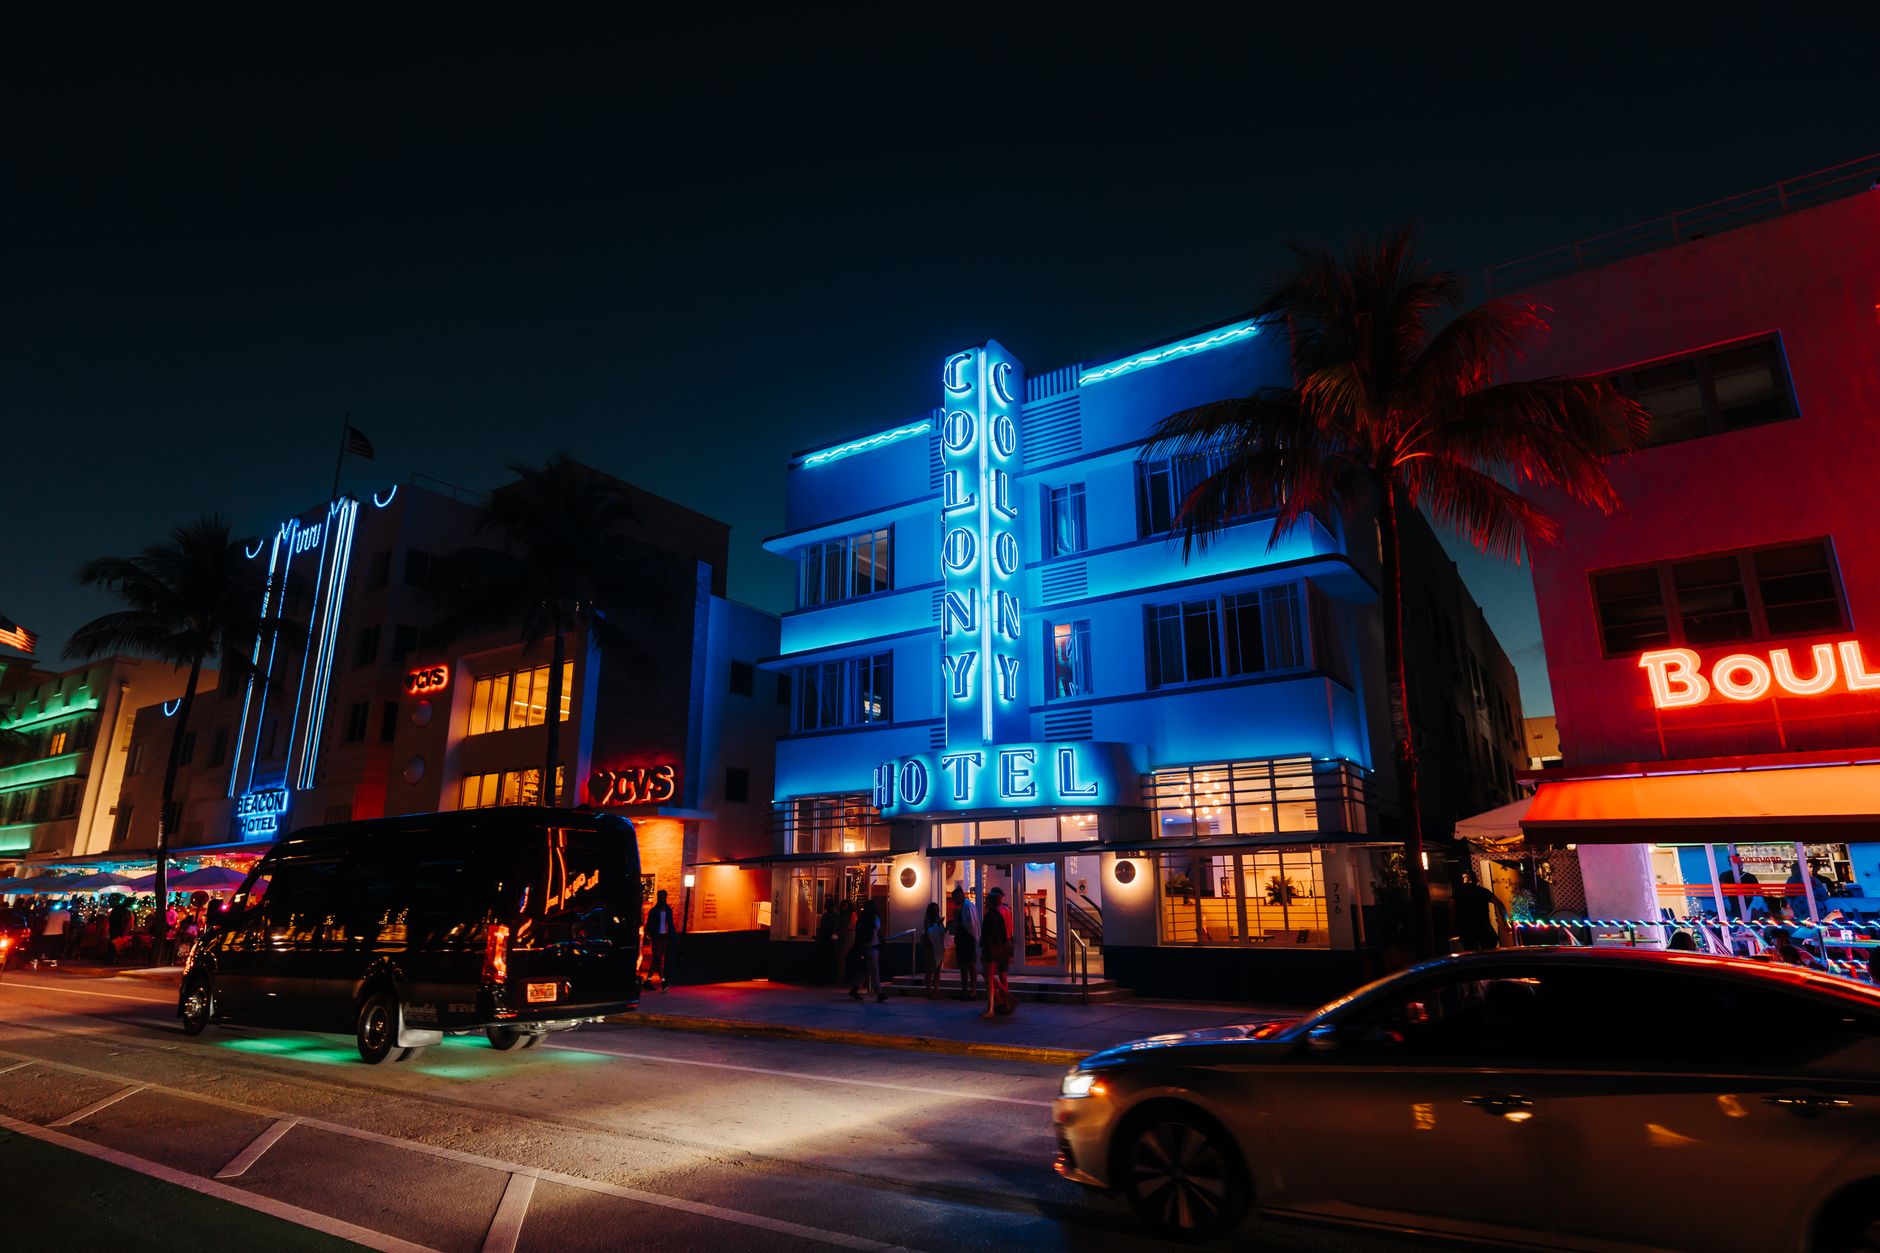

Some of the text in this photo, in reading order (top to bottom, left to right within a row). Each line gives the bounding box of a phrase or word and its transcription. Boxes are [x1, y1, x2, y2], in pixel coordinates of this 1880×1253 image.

[943, 353, 976, 699] COLONY
[991, 362, 1020, 702] COLONY
[415, 667, 446, 691] CVS
[613, 765, 675, 803] CVS
[873, 748, 1098, 809] HOTEL
[237, 790, 285, 814] BEACON
[240, 816, 278, 833] HOTEL
[1332, 882, 1342, 914] 736
